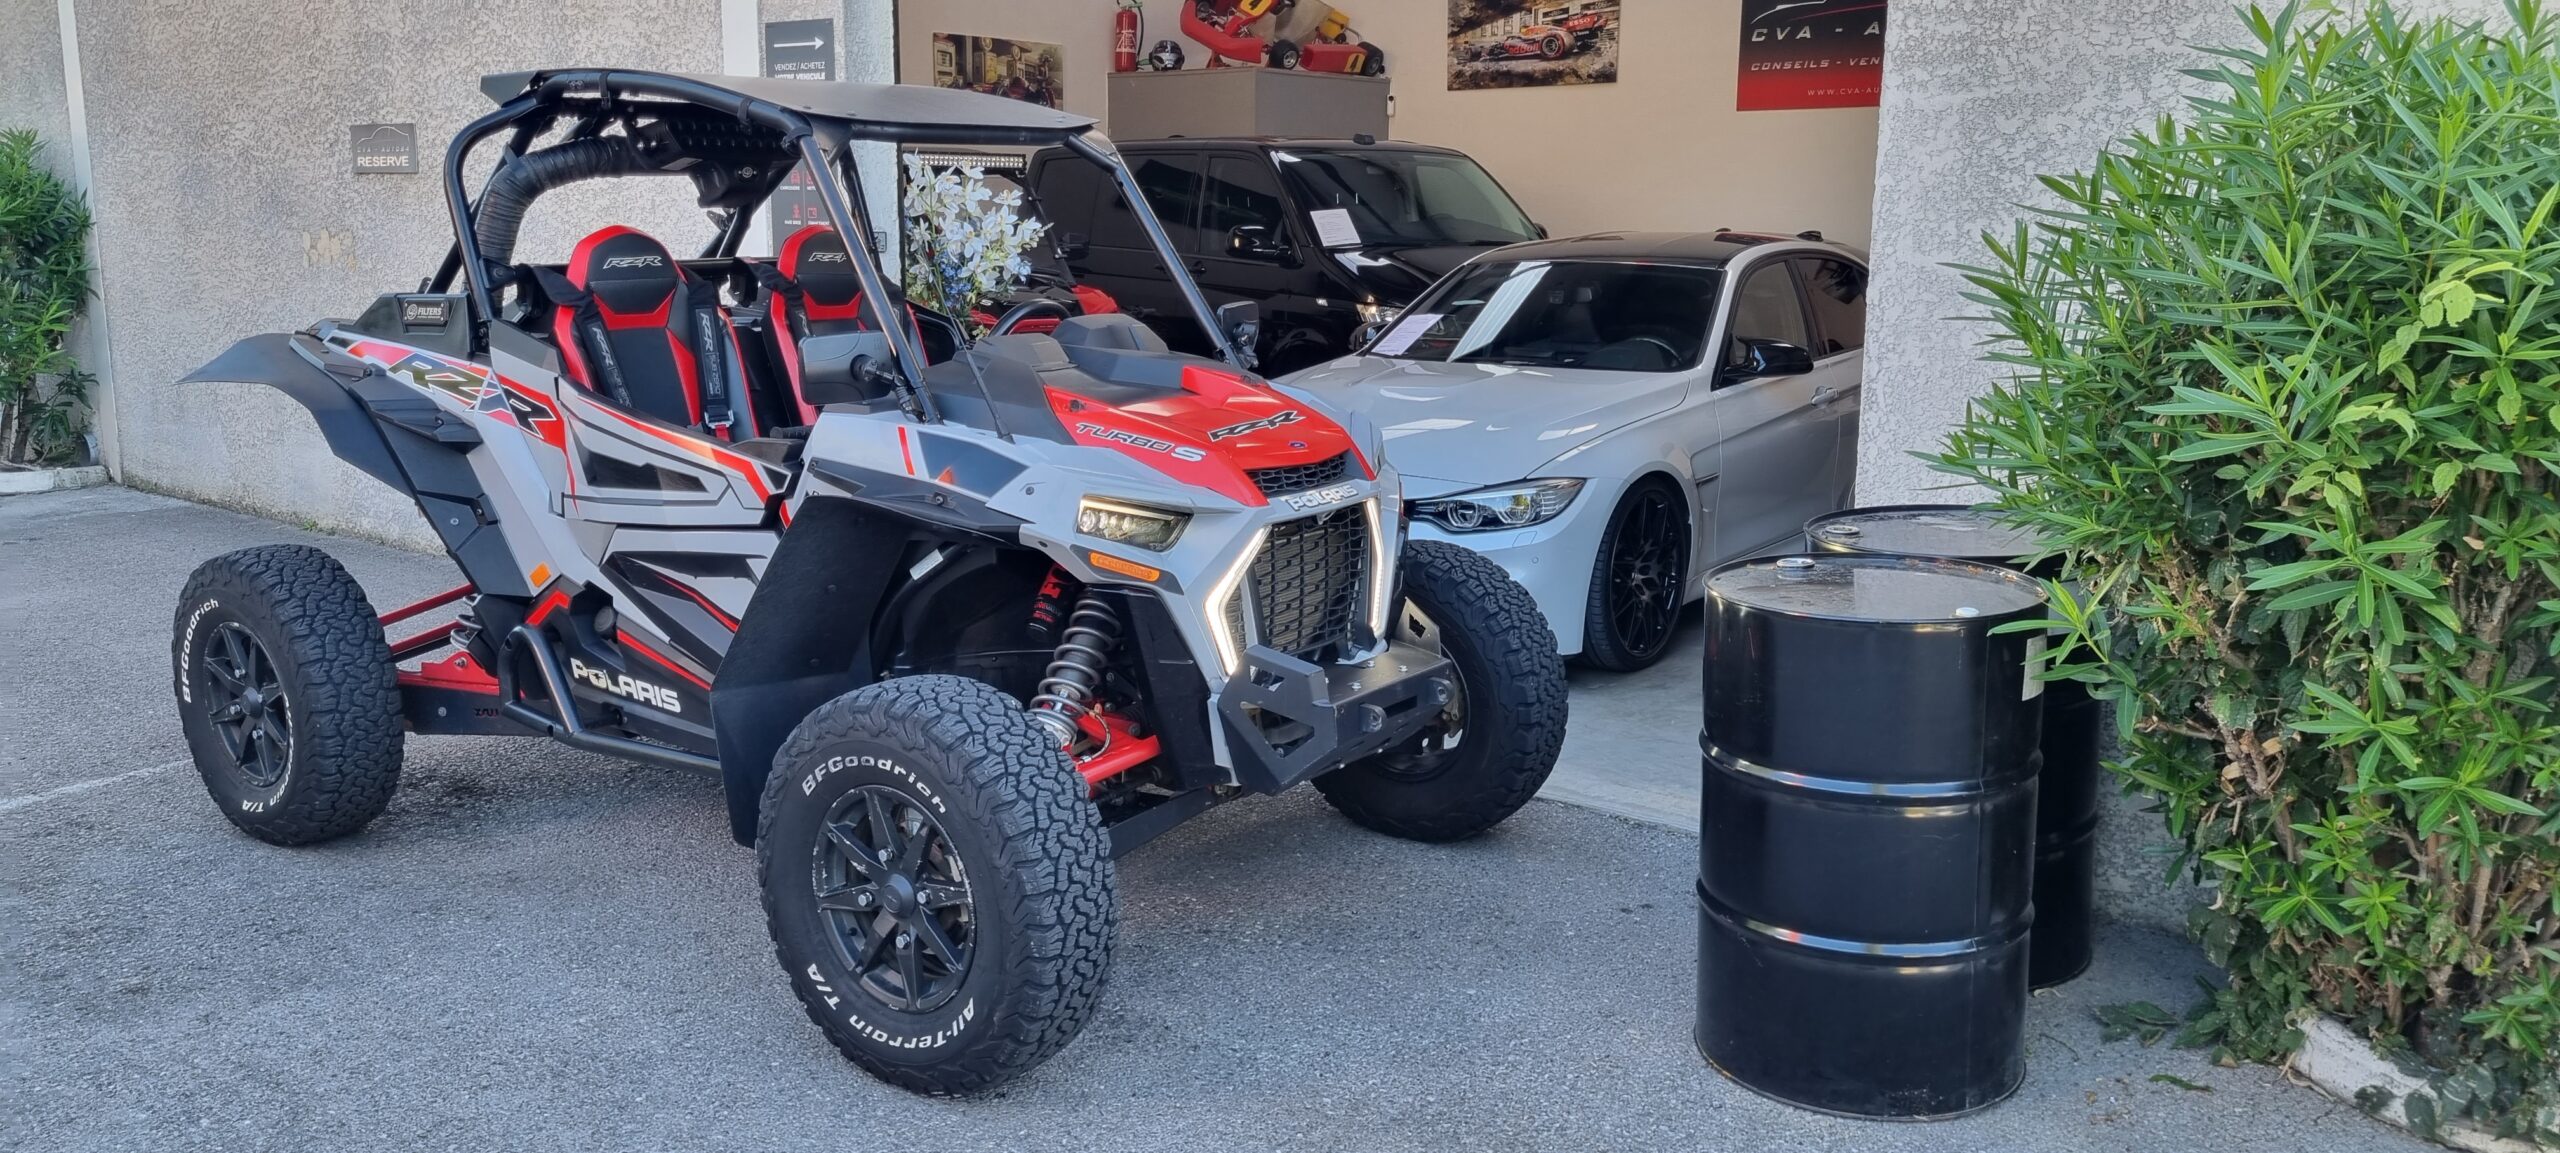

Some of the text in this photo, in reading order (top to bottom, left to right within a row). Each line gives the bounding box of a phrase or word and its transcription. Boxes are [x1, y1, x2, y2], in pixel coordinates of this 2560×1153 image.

[1751, 25, 1812, 42] CVA
[774, 63, 797, 72] VENDEZ
[800, 61, 825, 70] ACHETEZ
[1750, 59, 1830, 71] CONSEILS
[356, 155, 409, 167] RESERVE
[602, 255, 663, 270] RZR
[417, 307, 442, 316] FILTERS
[388, 352, 557, 440] RZR
[1077, 422, 1206, 462] TURBO S
[1207, 410, 1306, 442] RZR
[1287, 484, 1359, 511] POLARIS
[181, 598, 219, 704] BFGoodrich
[569, 657, 682, 713] POLARIS
[801, 755, 946, 814] BFGoodrich
[807, 963, 841, 1011] T/A
[848, 997, 975, 1050] All-Terrain
